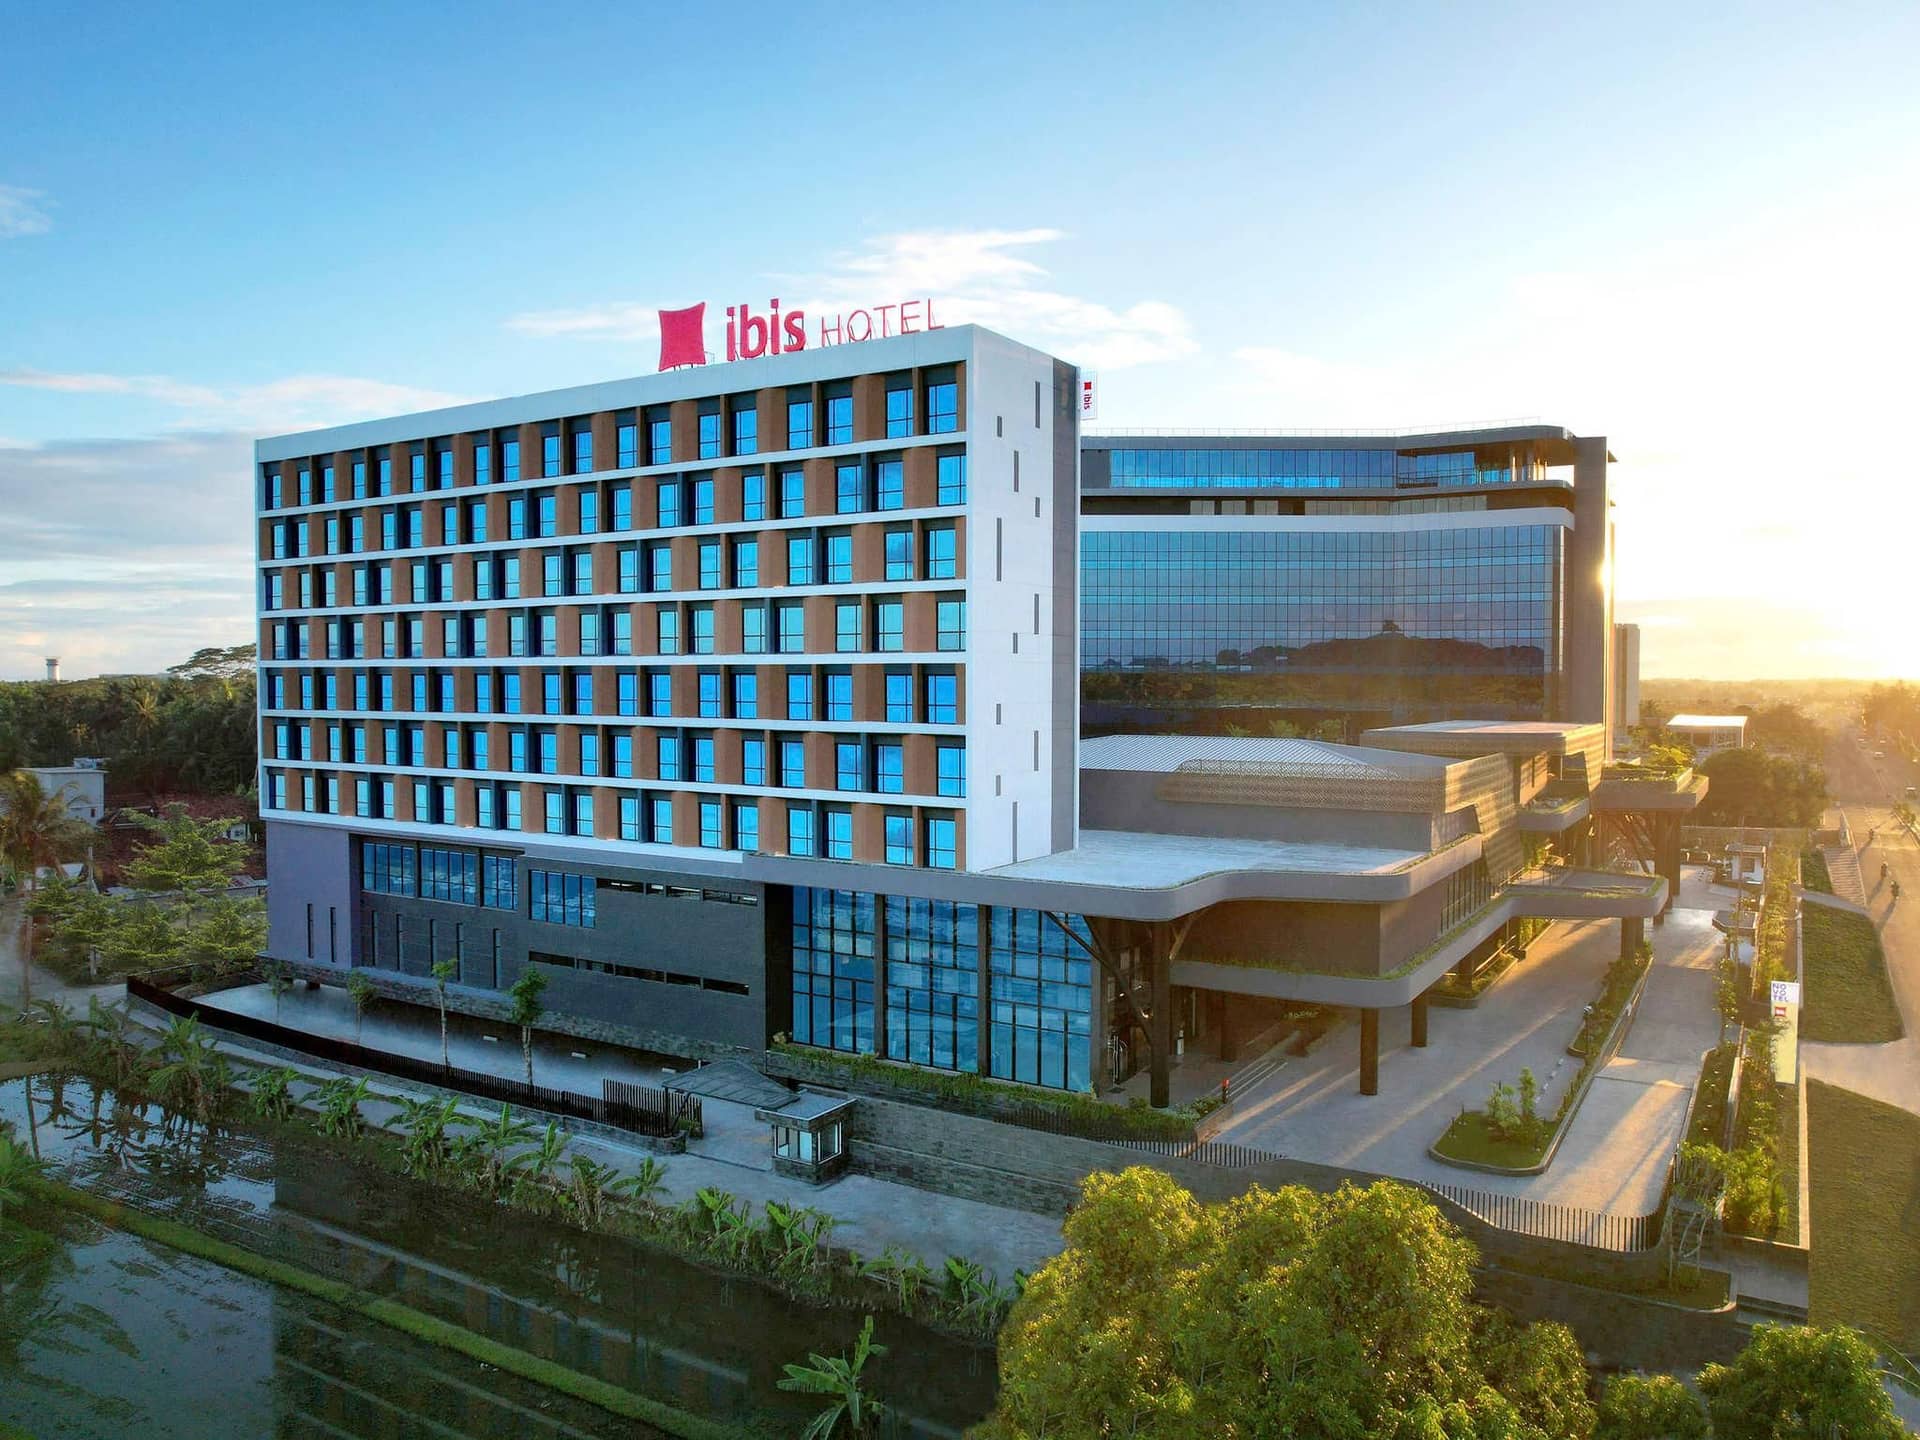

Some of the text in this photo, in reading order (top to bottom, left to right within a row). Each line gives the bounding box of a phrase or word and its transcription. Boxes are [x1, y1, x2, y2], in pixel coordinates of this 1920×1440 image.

[726, 298, 945, 361] ibis HOTEL
[1084, 393, 1092, 410] ibis
